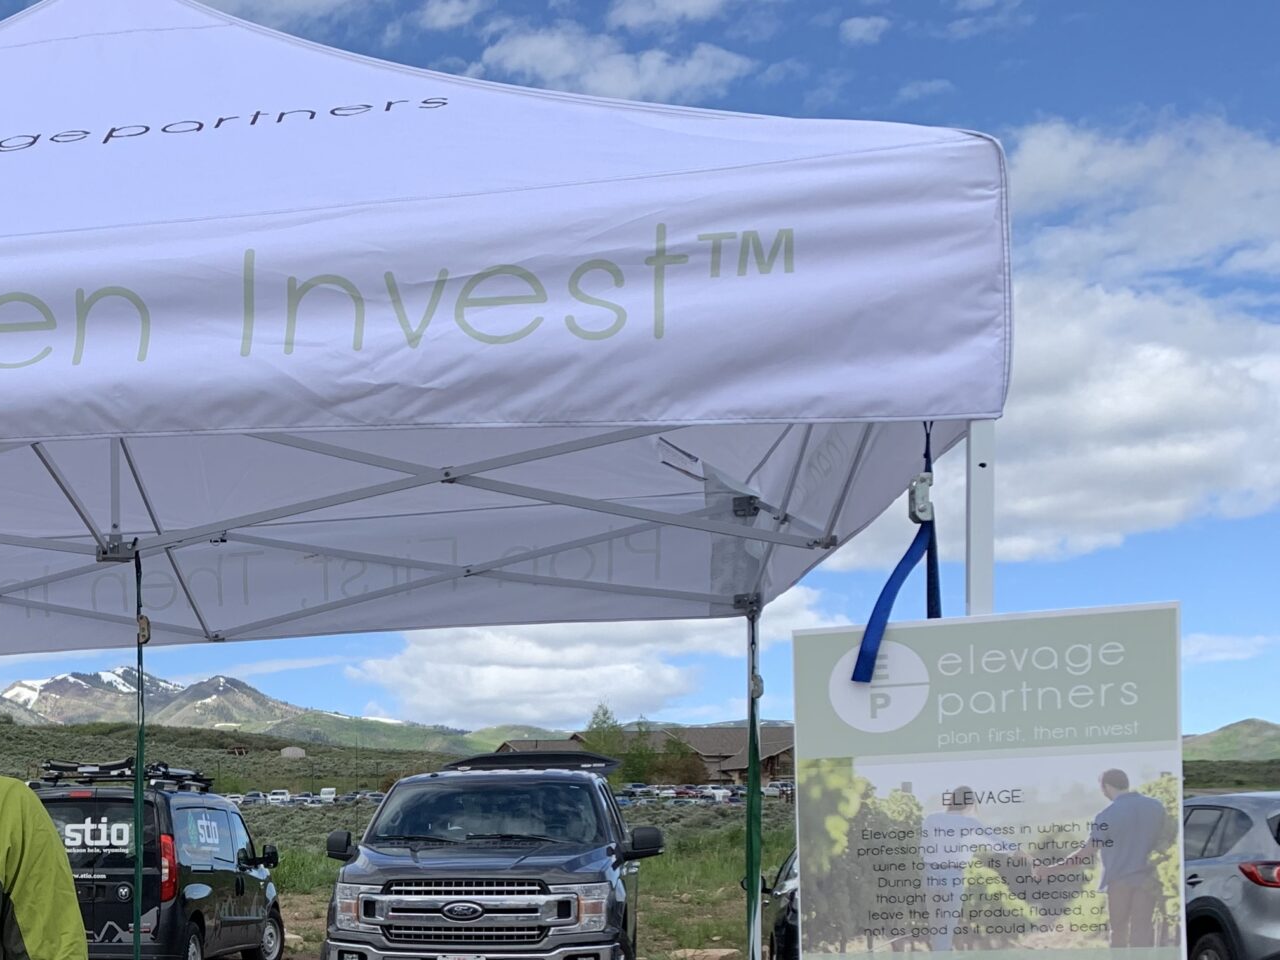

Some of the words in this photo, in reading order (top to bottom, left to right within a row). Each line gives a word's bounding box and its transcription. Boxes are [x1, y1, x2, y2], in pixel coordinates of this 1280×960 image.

[937, 641, 1125, 675] elevage
[869, 693, 891, 719] P
[937, 681, 1138, 724] partners
[938, 730, 980, 748] plan
[1034, 724, 1077, 740] then
[1086, 721, 1140, 735] invest
[65, 816, 129, 846] stio
[920, 828, 928, 838] is
[934, 828, 954, 837] the
[961, 825, 1014, 837] process
[1021, 824, 1031, 833] in
[1038, 823, 1080, 833] which
[1086, 821, 1108, 831] the
[857, 844, 937, 857] professional
[944, 841, 1023, 853] winemaker
[1028, 839, 1085, 850] nurtures
[1091, 838, 1113, 848] the
[873, 861, 905, 872] wine
[912, 860, 925, 870] to
[931, 857, 982, 869] achieve
[988, 856, 1000, 868] its
[1006, 855, 1027, 867] full
[878, 877, 921, 888] During
[927, 875, 947, 886] this
[1015, 876, 1041, 886] any
[876, 894, 926, 905] thought
[932, 892, 953, 902] out
[960, 892, 972, 901] or
[979, 891, 1026, 901] rushed
[1032, 889, 1096, 900] decisions
[869, 910, 903, 920] leave
[909, 909, 929, 919] the
[935, 908, 963, 918] final
[969, 908, 1024, 920] product
[1090, 906, 1104, 914] or
[864, 926, 885, 936] not
[890, 926, 905, 935] as
[912, 925, 947, 937] good
[953, 926, 968, 934] as
[973, 924, 980, 933] it
[986, 923, 1025, 933] could
[1031, 922, 1063, 932] have
